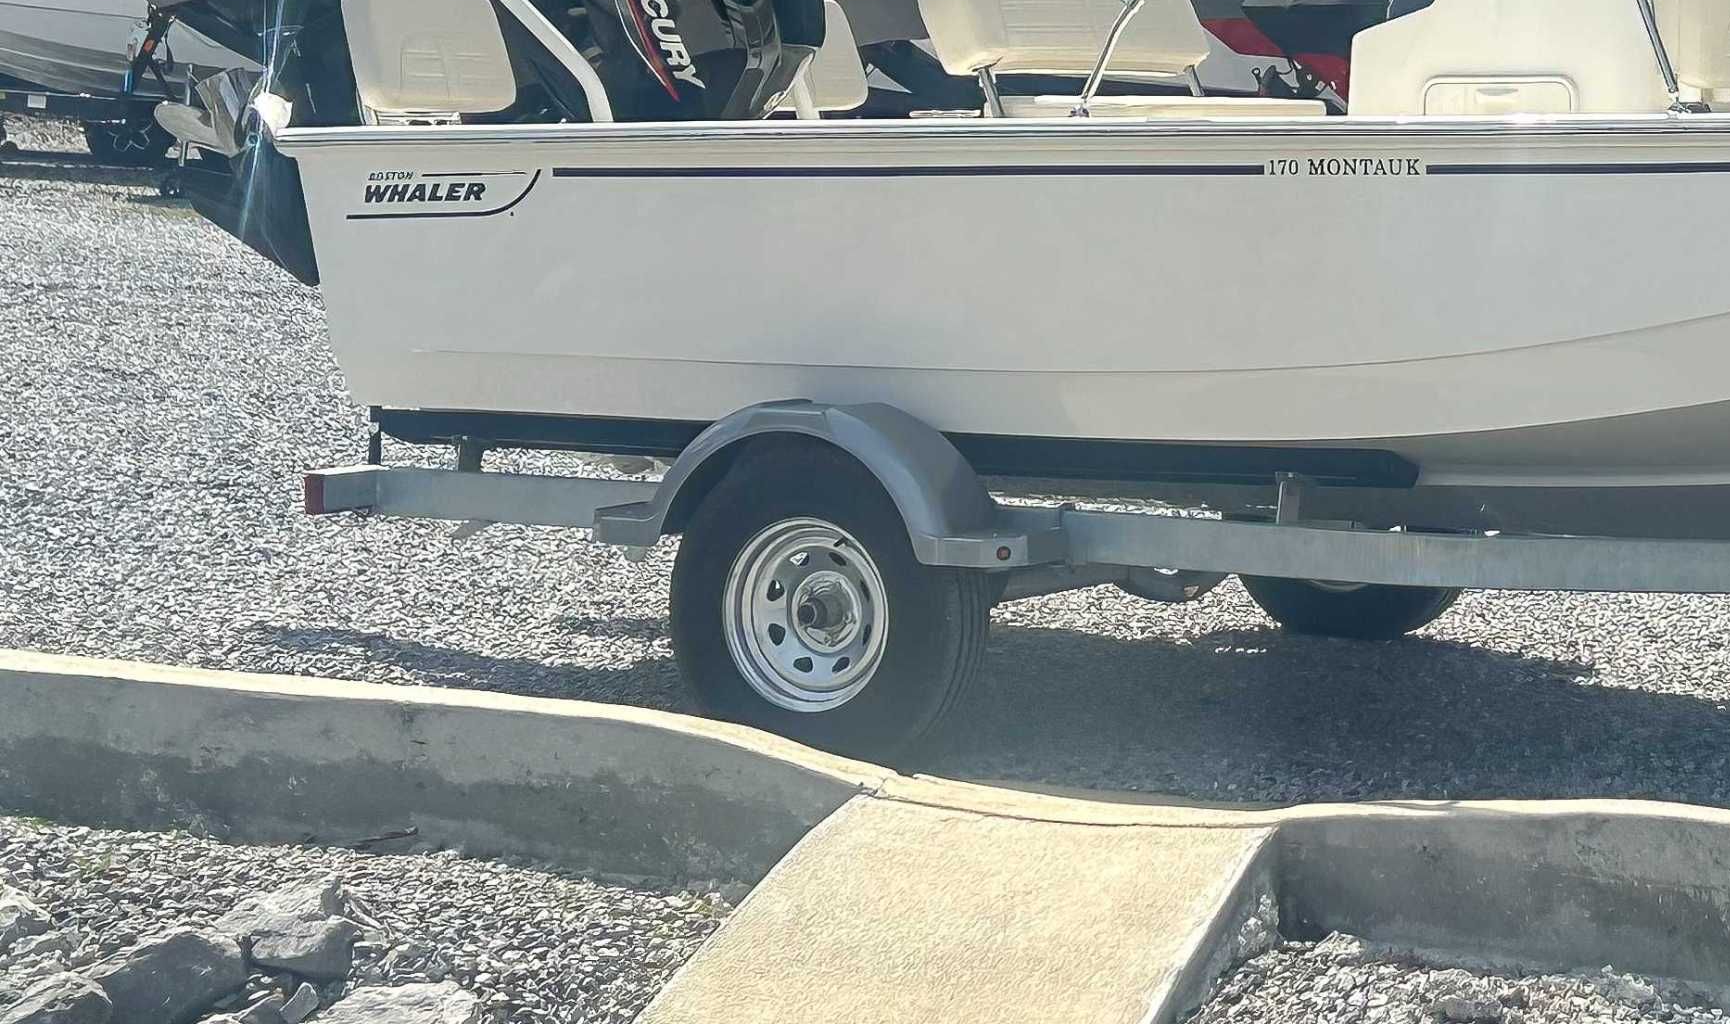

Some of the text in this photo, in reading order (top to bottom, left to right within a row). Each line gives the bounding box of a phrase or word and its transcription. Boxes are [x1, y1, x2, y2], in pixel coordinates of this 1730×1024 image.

[1269, 158, 1421, 176] 170 MONTAUK
[364, 182, 487, 204] WHALER
